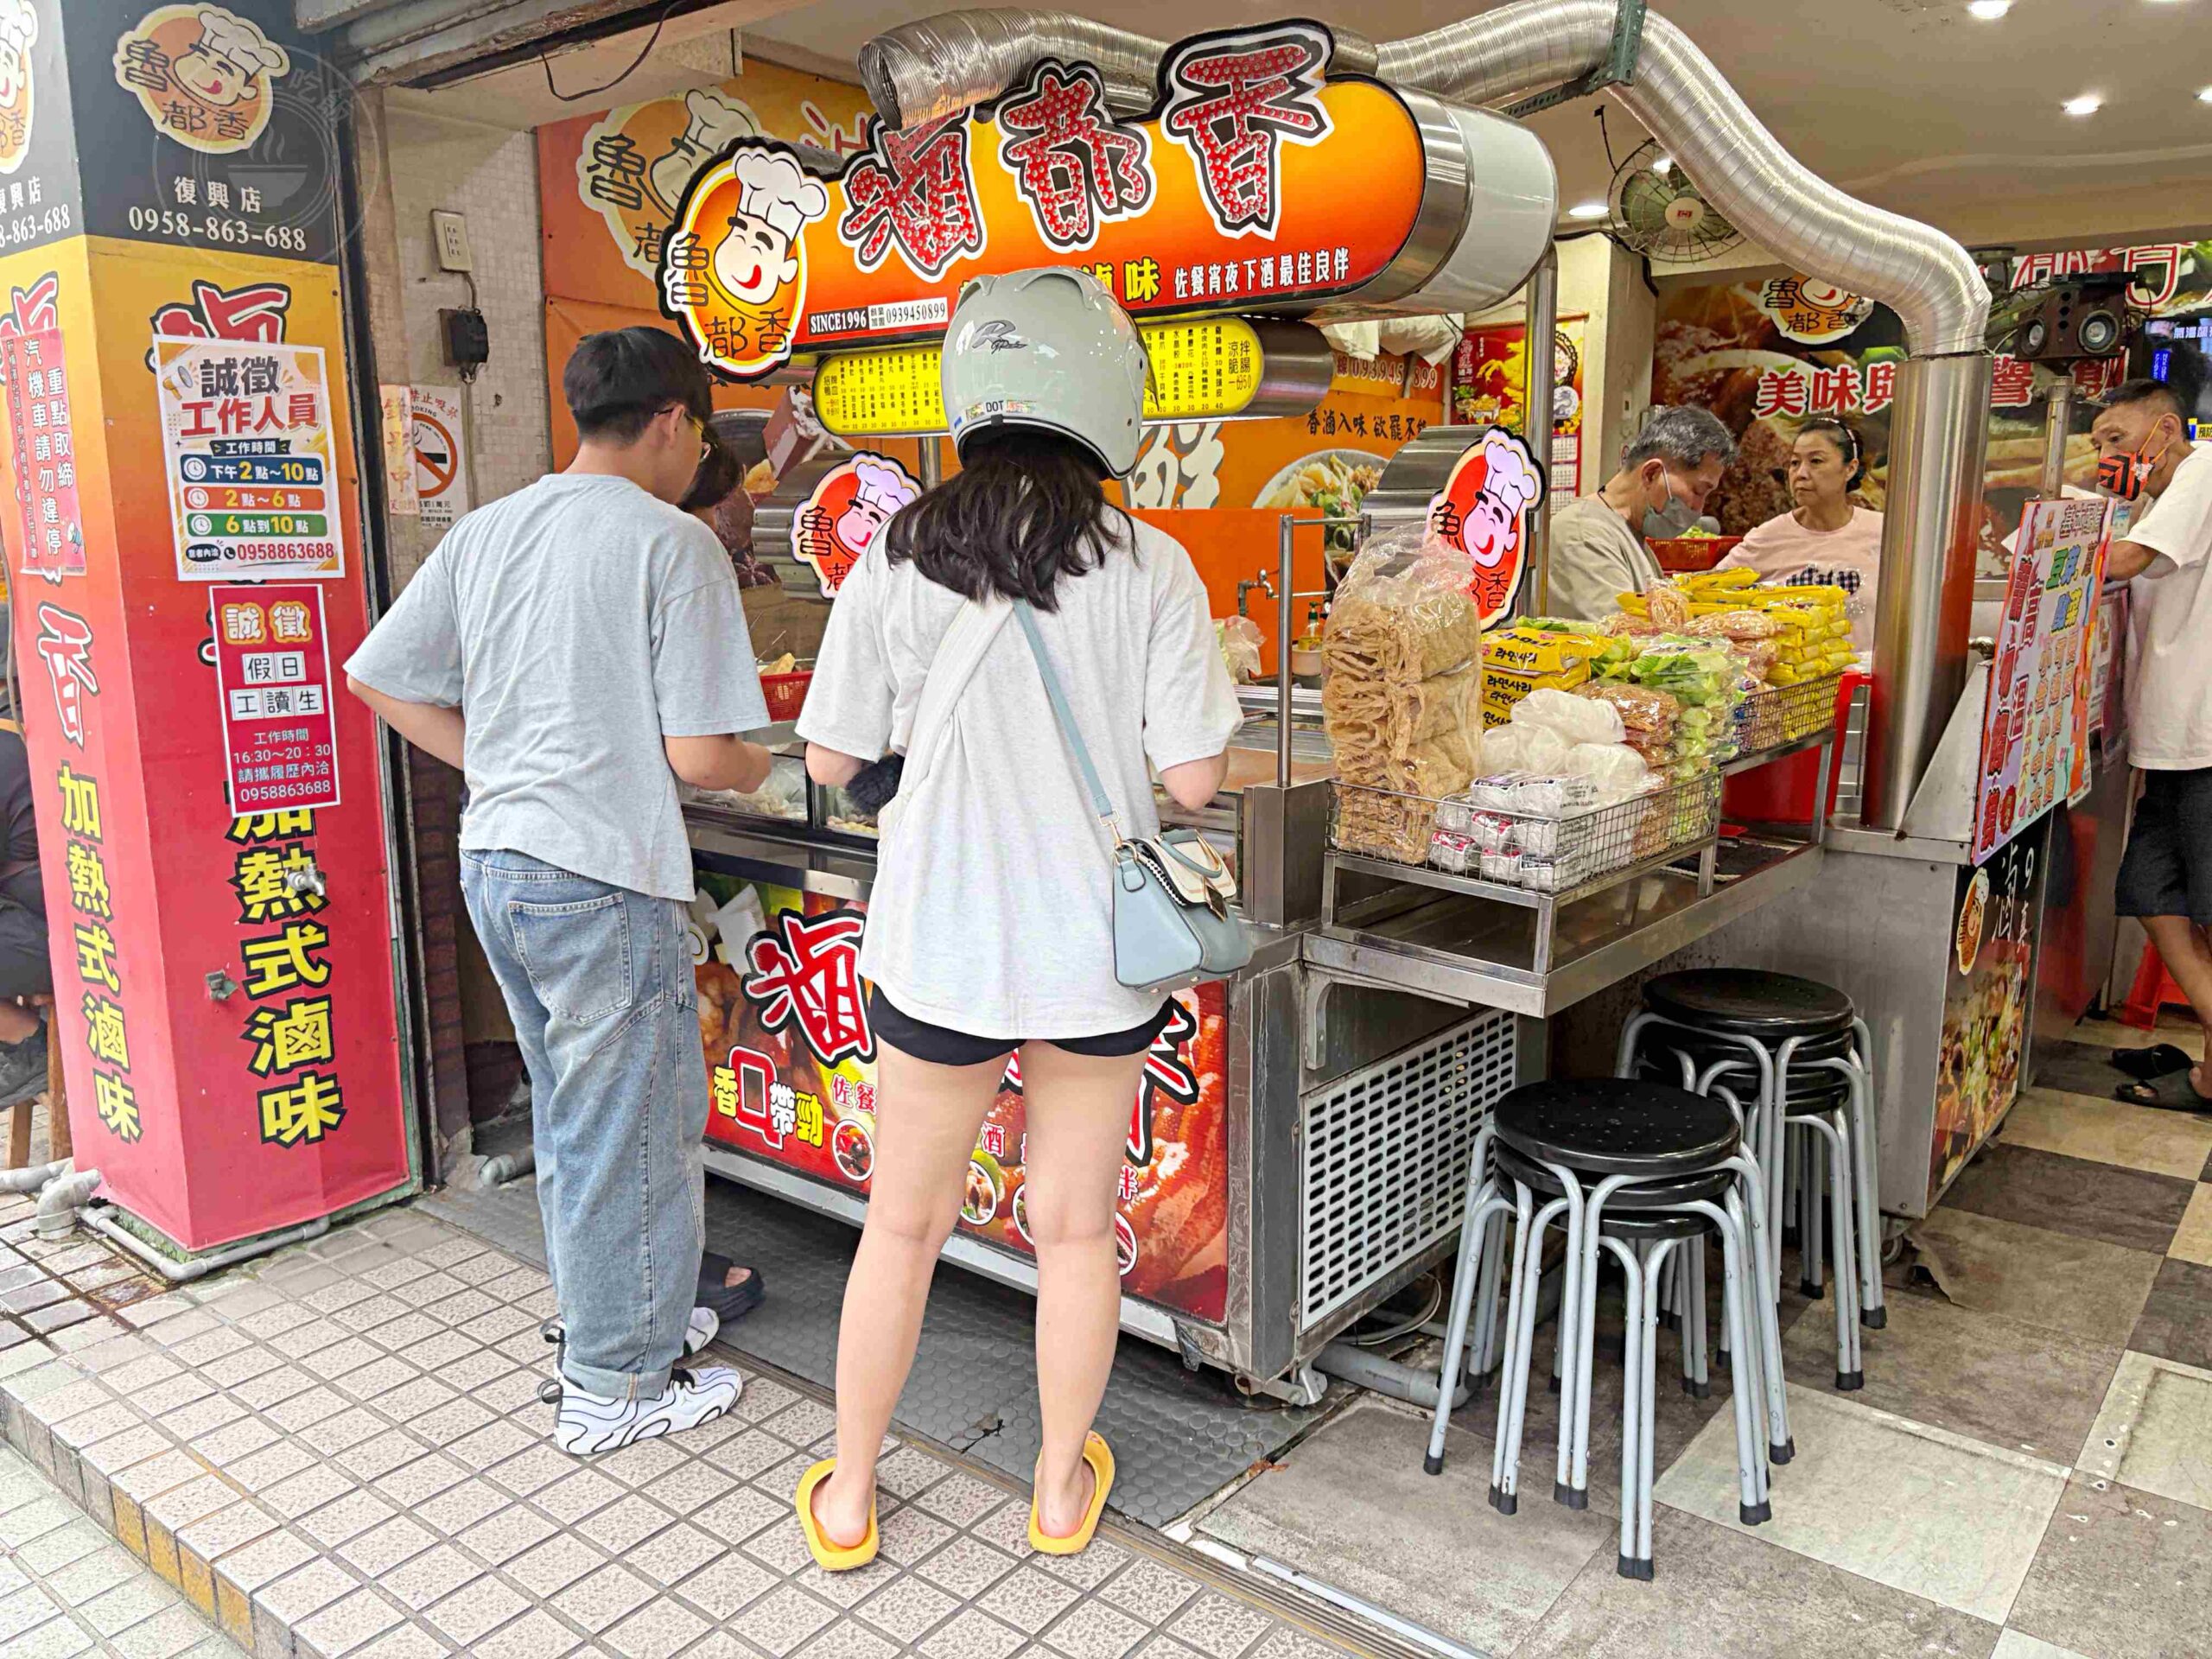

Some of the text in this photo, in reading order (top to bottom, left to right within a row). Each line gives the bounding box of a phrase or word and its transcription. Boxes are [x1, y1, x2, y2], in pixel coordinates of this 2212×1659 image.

[174, 175, 261, 213] 復興店
[129, 206, 307, 251] 0958-863-688
[200, 355, 280, 398] 誠徵
[180, 393, 320, 437] 工作人員
[985, 400, 1004, 412] DOT
[47, 367, 73, 489] 重點取締
[23, 338, 62, 556] 汽機車請勿違停
[226, 442, 276, 454] 工作時間
[226, 515, 309, 534] 6點到10點
[237, 542, 335, 561] 0958863688
[226, 605, 308, 640] 誠徵
[247, 657, 300, 680] 假日
[1487, 675, 1532, 694] 라면사리
[236, 690, 320, 714] 工讀生
[254, 728, 309, 746] 工作時間
[240, 780, 331, 804] 0958863688
[58, 765, 143, 1142] 加熱式滷味
